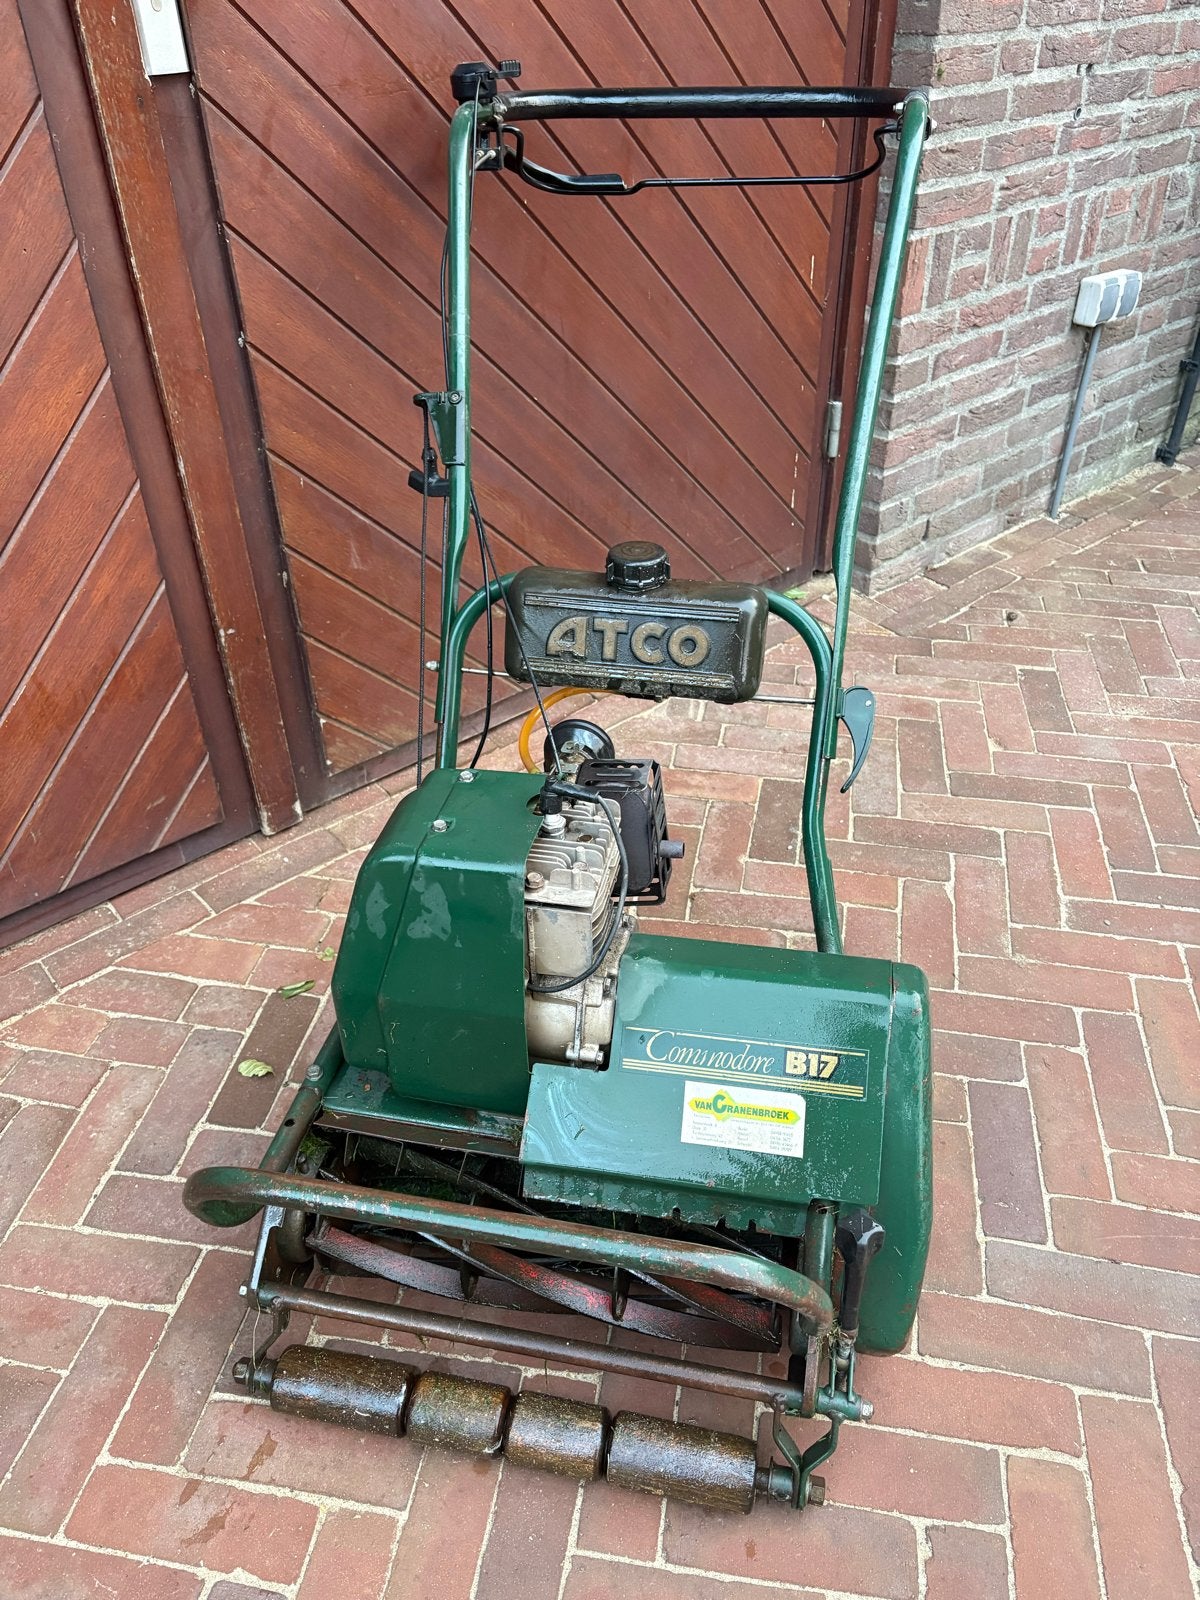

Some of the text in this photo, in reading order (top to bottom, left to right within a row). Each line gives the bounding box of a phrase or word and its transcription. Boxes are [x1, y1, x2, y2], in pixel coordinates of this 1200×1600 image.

[546, 616, 711, 667] ATCO
[646, 1030, 839, 1079] Commodore B17
[694, 1099, 712, 1111] VAN
